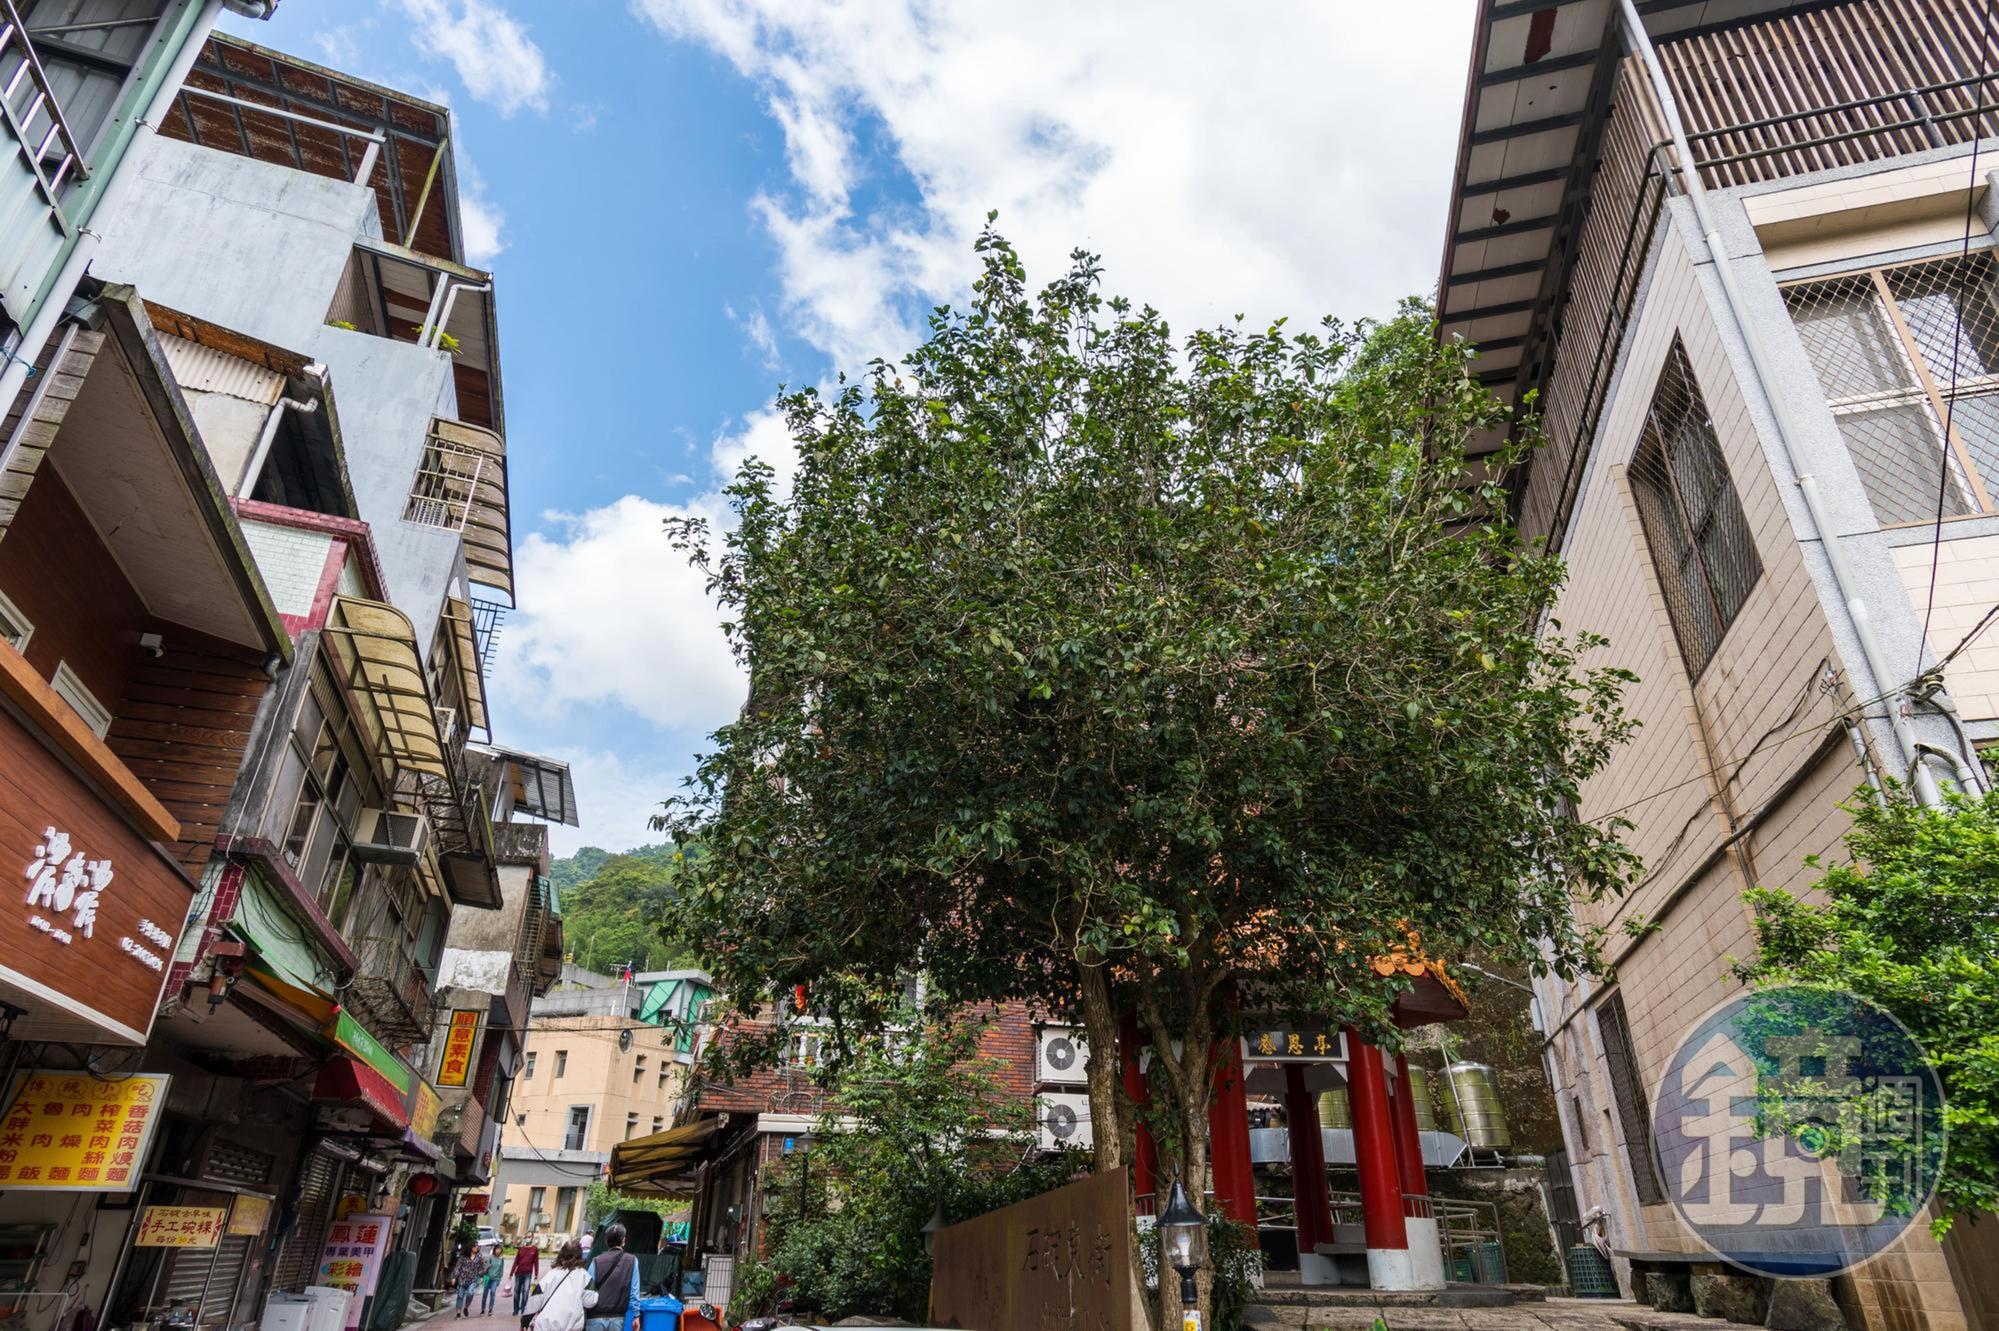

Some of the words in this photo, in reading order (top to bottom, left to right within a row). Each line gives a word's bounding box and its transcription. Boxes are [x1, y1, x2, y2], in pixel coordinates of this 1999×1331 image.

[445, 1012, 476, 1073] 順意素食
[1258, 1032, 1331, 1055] 感恩亭
[29, 1079, 148, 1096] 傳統小吃
[75, 1104, 122, 1181] 榨菜肉絲麵
[151, 1219, 212, 1234] 手工碗粿
[325, 1246, 374, 1258] 專業美甲
[328, 1262, 363, 1277] 彩繪
